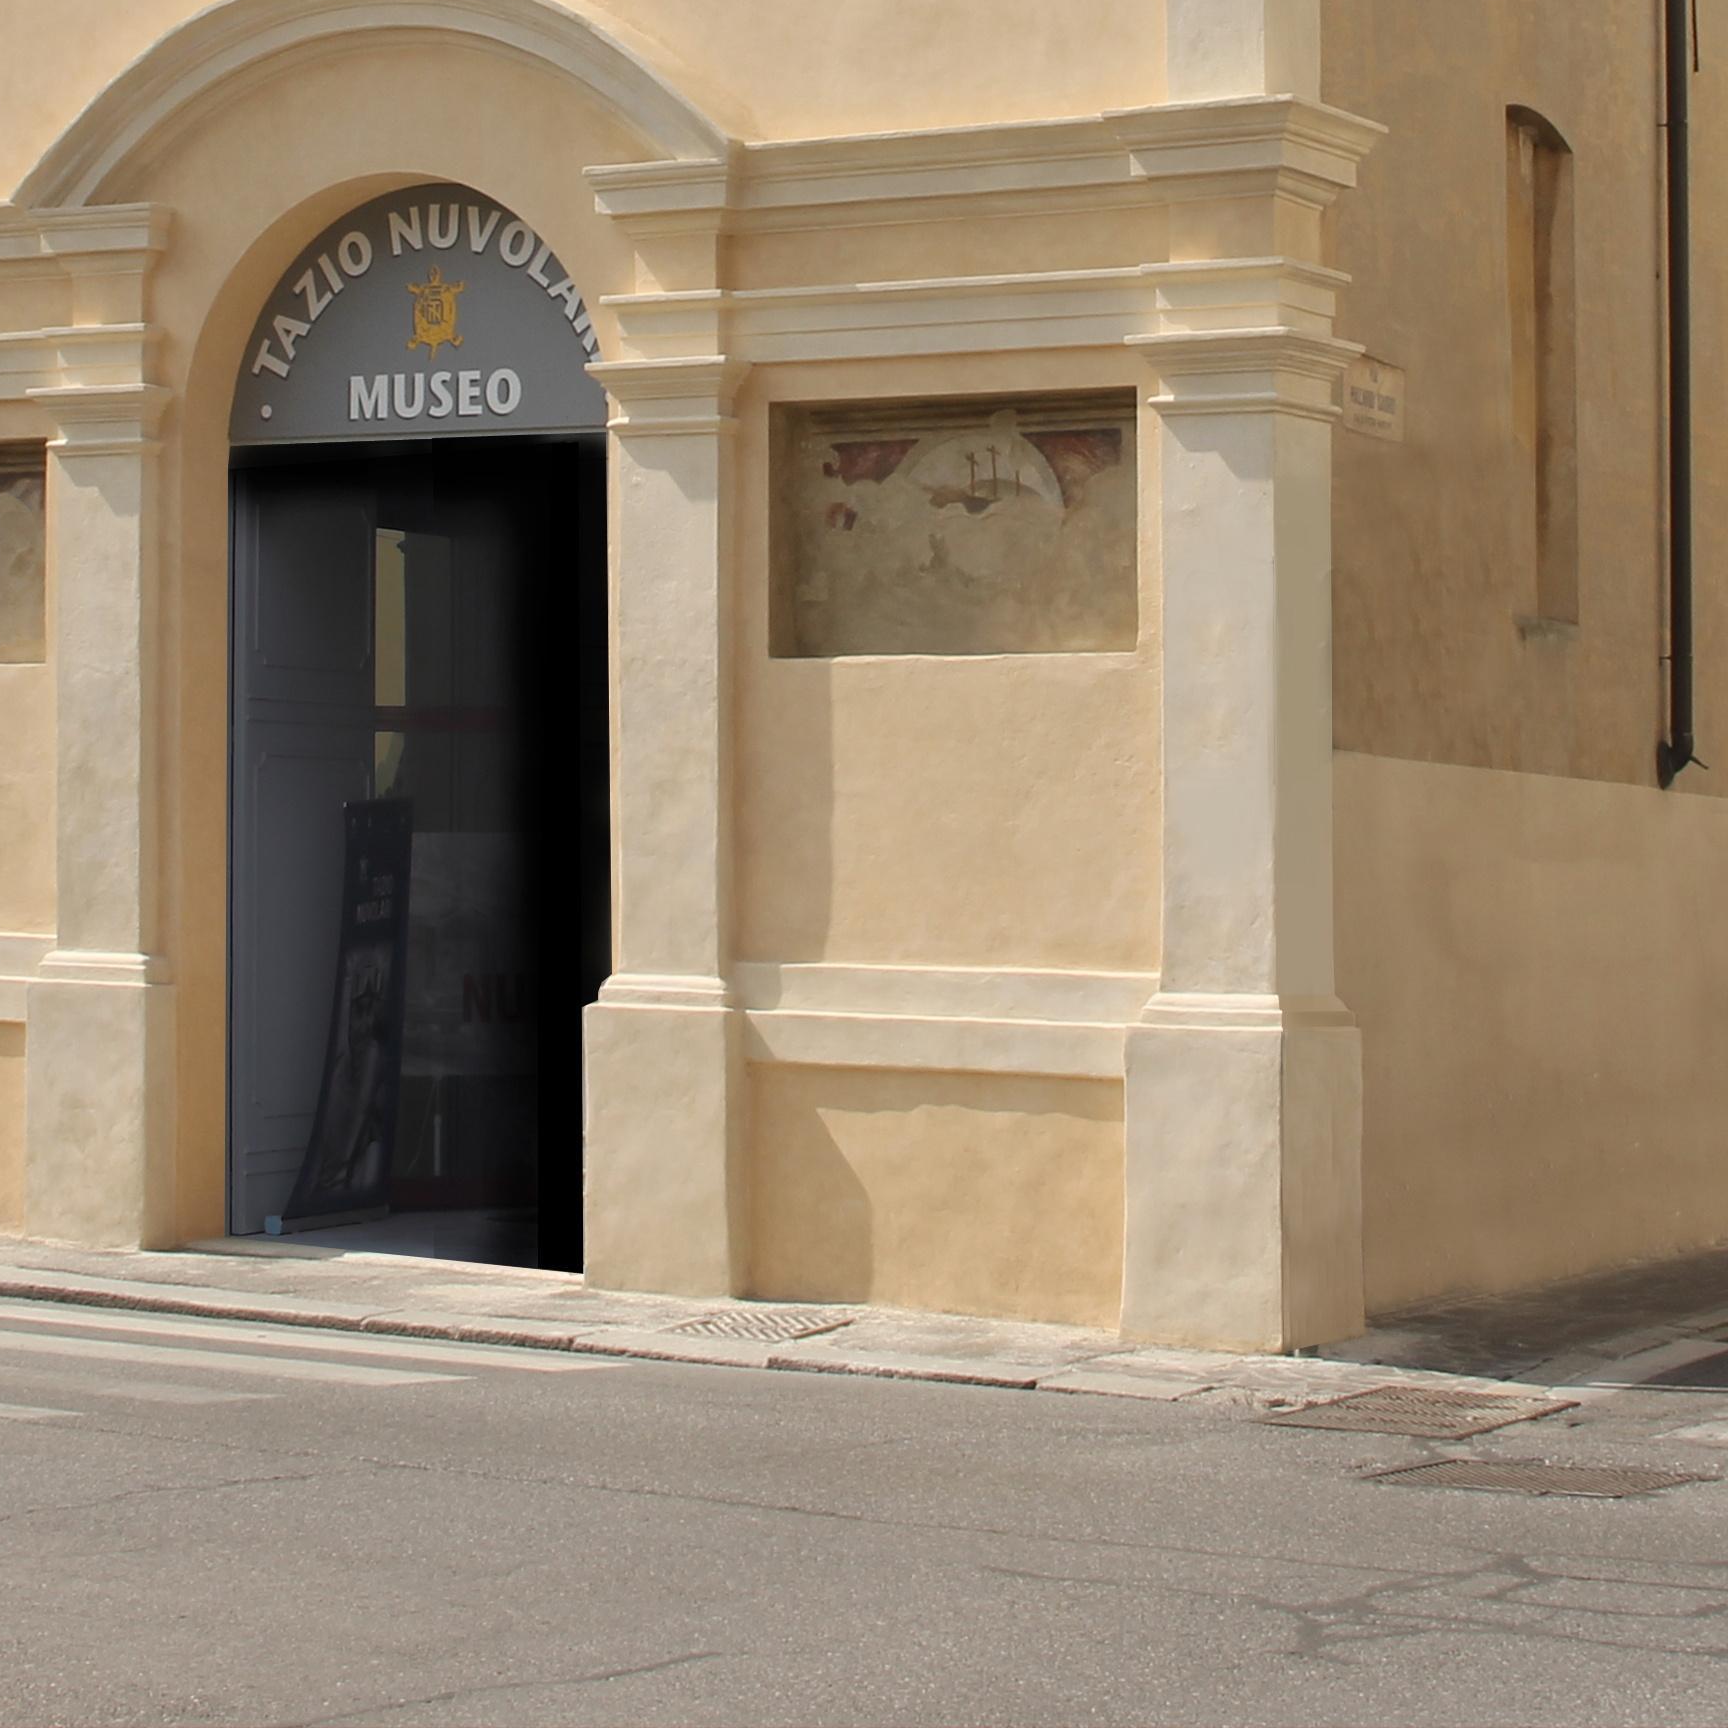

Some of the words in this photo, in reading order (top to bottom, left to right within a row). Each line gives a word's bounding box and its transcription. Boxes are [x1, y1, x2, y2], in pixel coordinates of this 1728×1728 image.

[251, 231, 373, 379] TAZIO
[388, 203, 603, 364] NUVOLA
[348, 368, 522, 421] MUSEO
